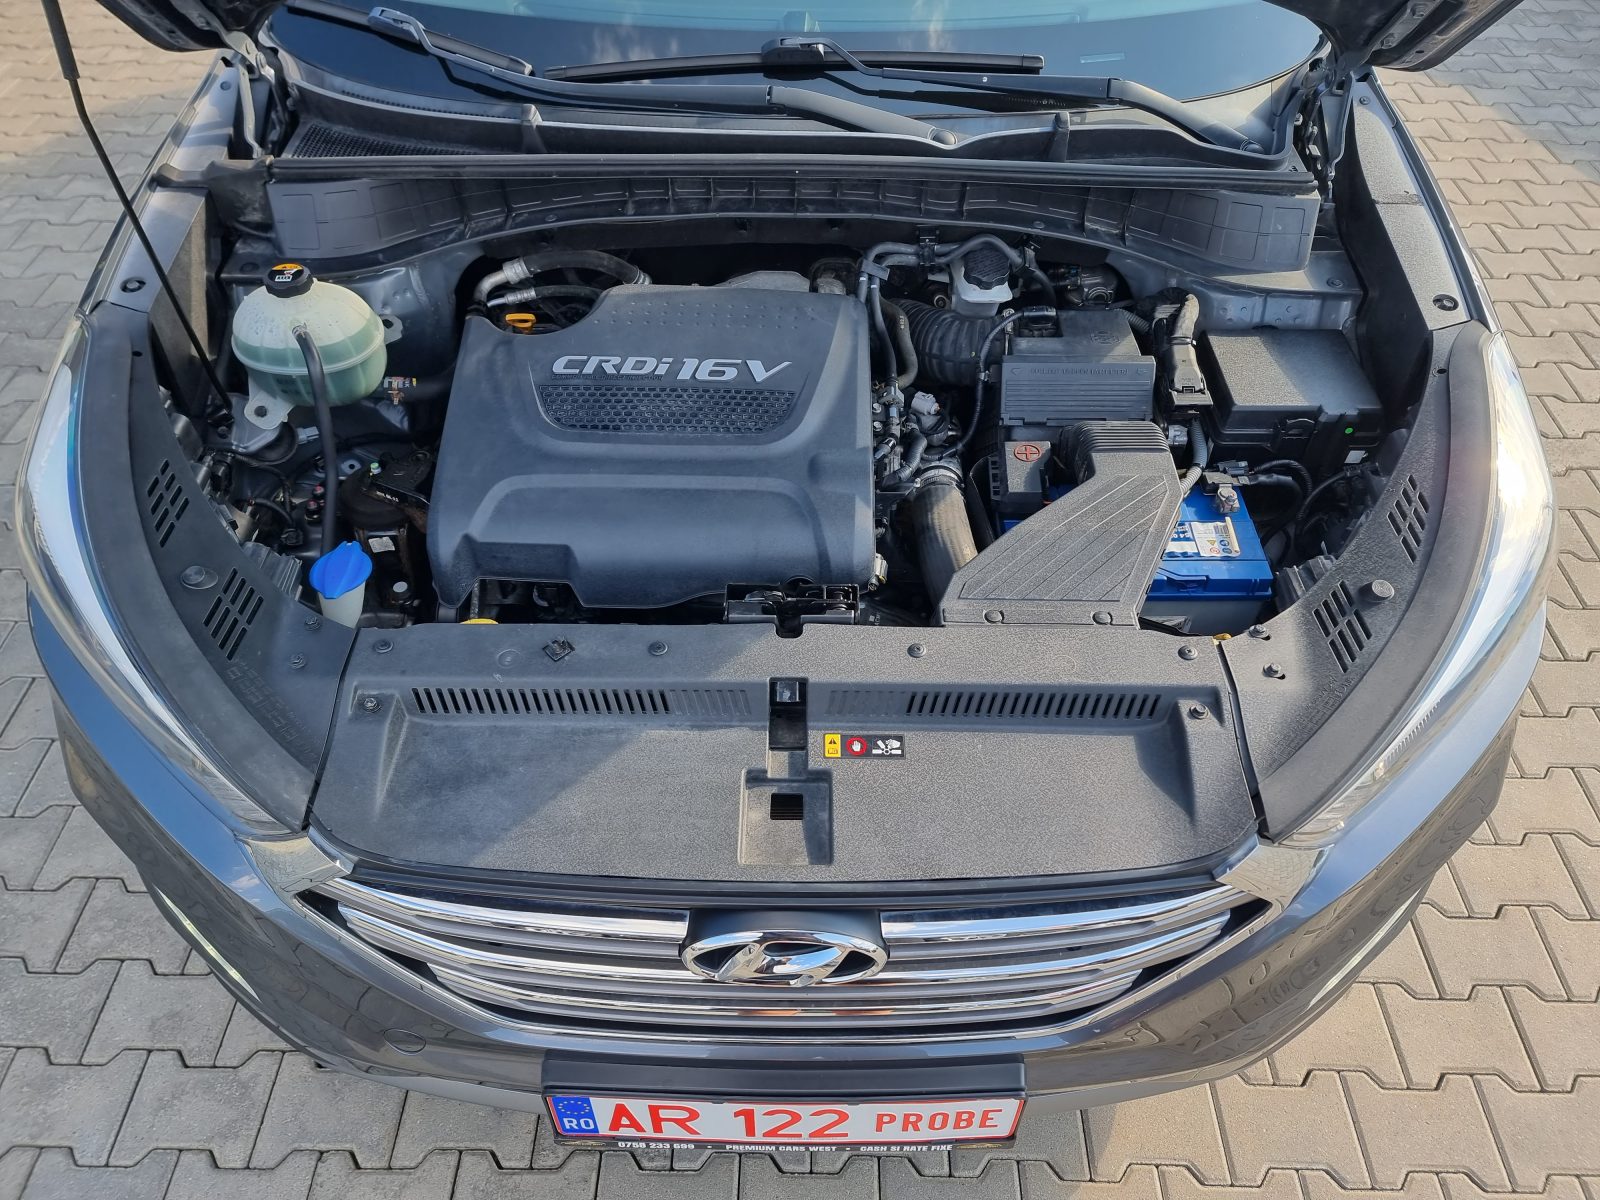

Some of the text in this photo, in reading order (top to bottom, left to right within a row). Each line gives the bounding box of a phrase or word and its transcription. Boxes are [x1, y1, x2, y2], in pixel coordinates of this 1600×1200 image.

[552, 355, 673, 375] CRDi
[562, 1117, 595, 1130] RO
[608, 1103, 1002, 1138] AR 122 PROBE
[650, 1142, 671, 1150] 233
